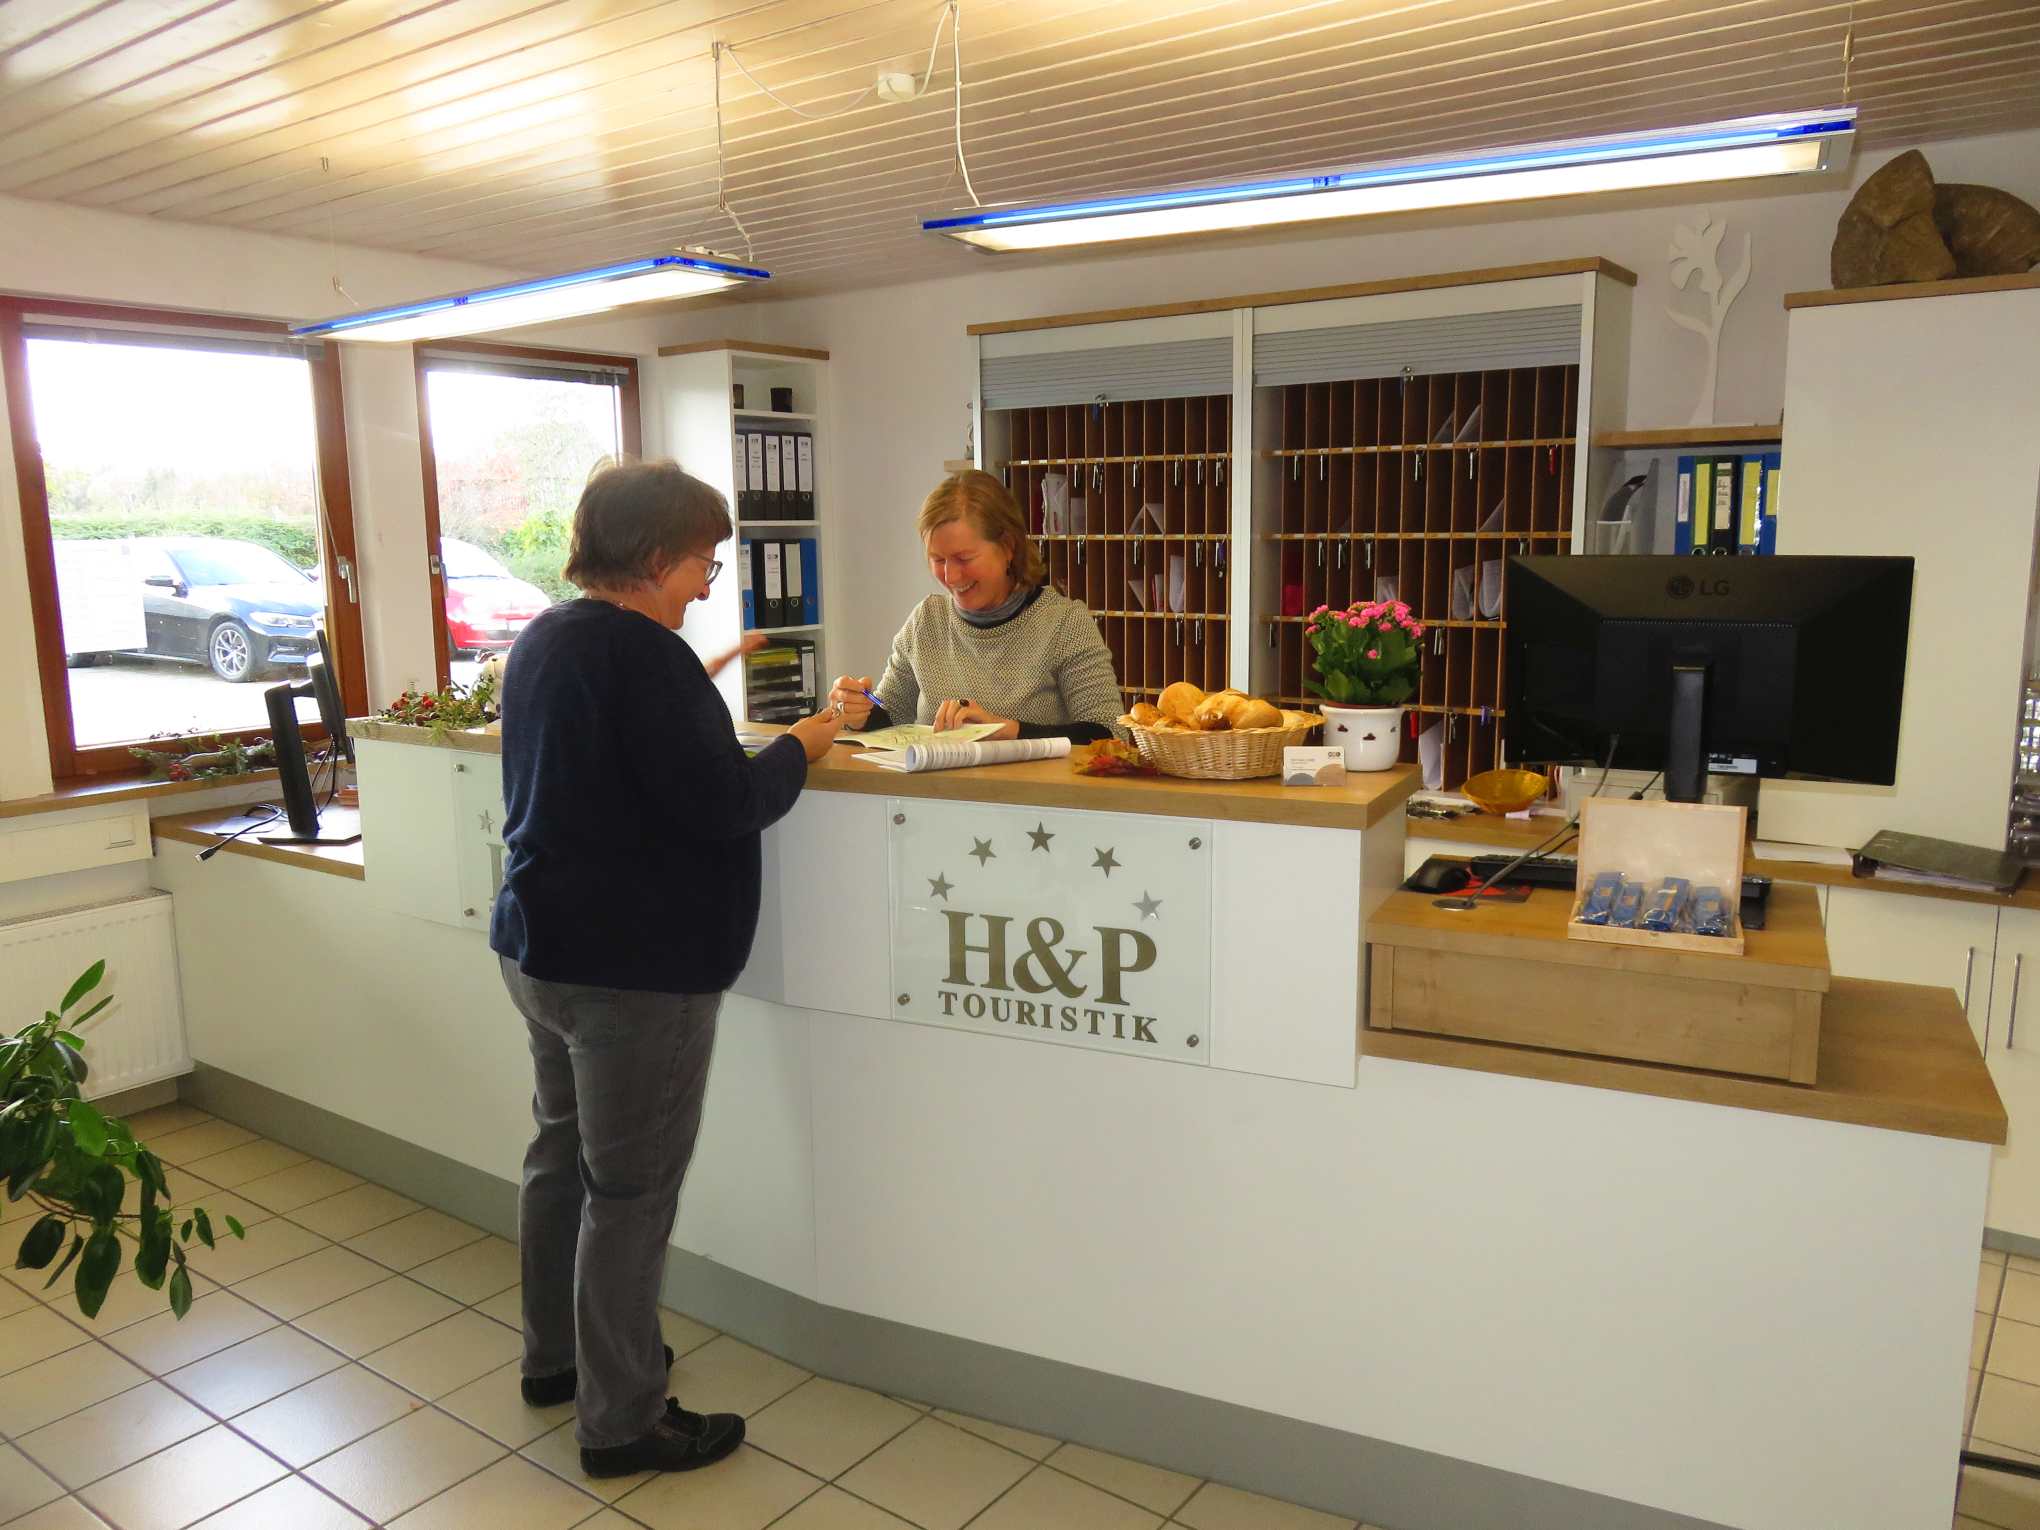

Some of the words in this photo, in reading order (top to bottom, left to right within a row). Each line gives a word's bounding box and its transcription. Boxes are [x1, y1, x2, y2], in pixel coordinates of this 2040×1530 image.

[1700, 579, 1729, 596] LG
[941, 909, 1157, 1006] H&P
[938, 991, 1158, 1043] TOURISTIK
